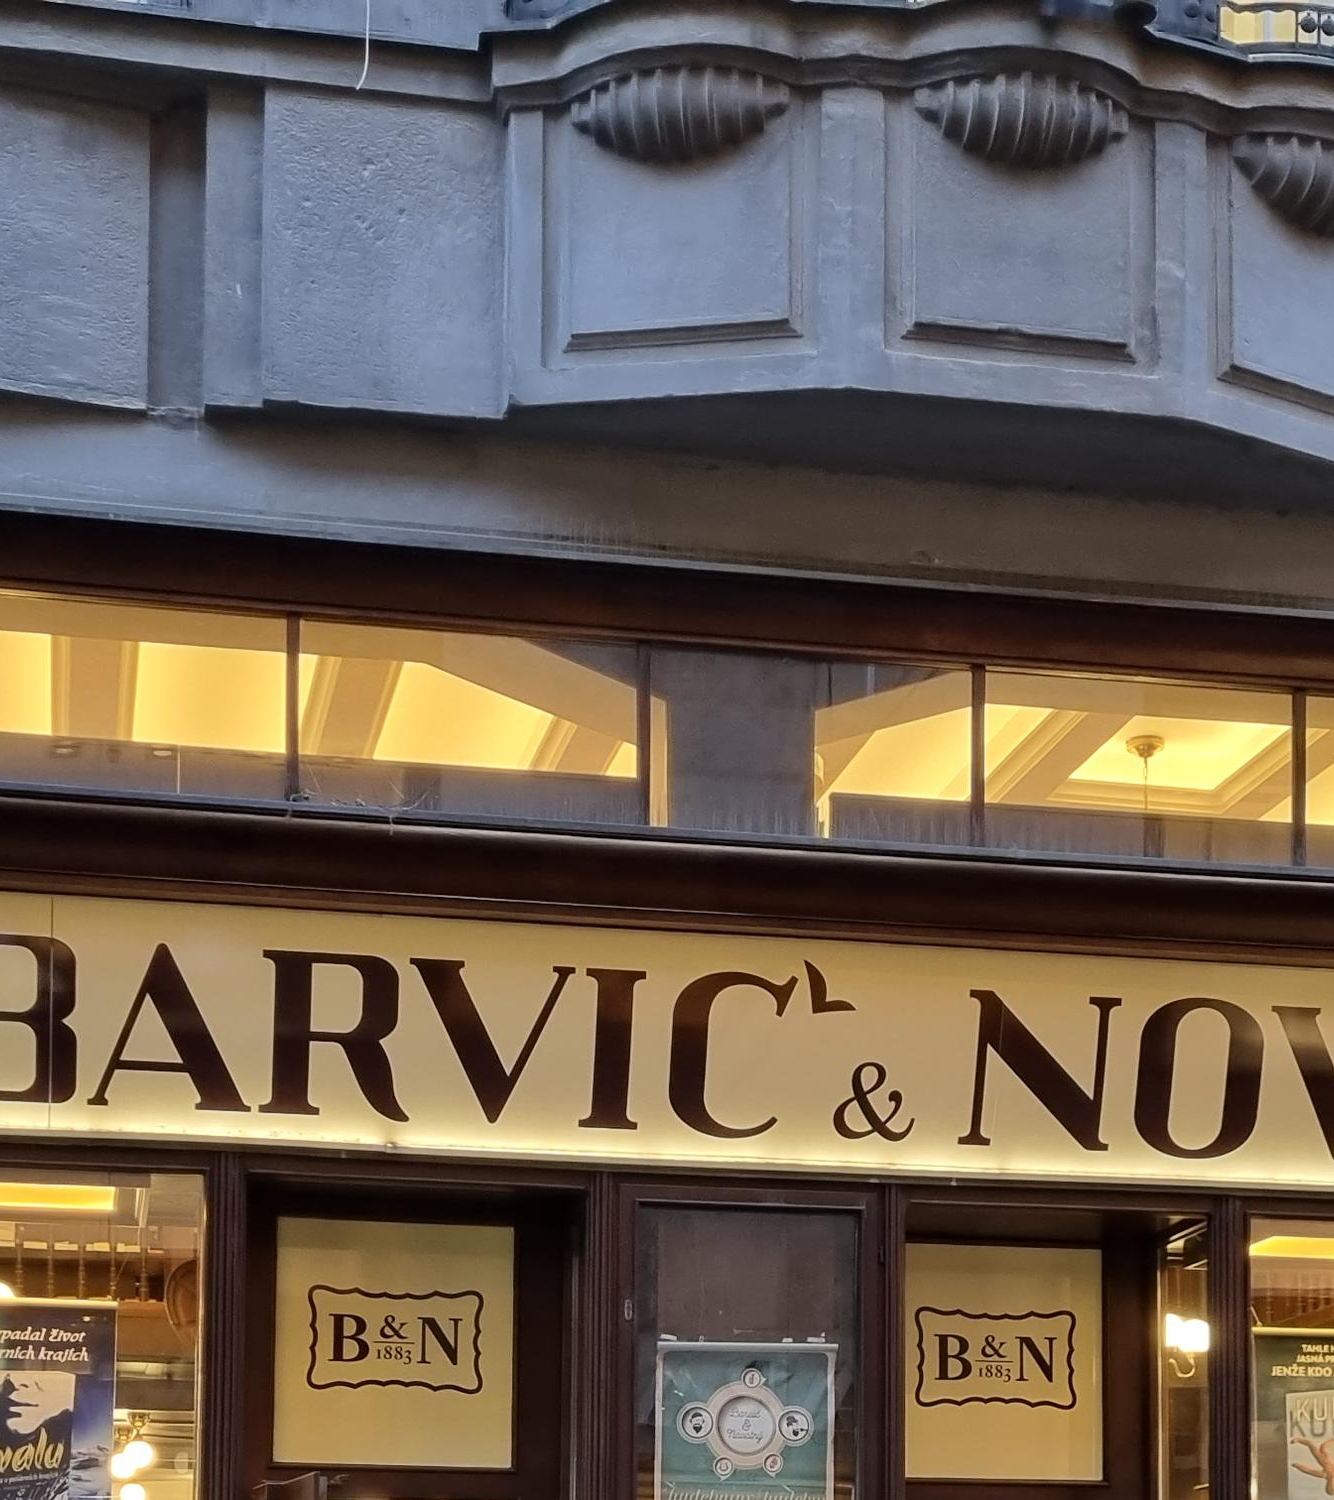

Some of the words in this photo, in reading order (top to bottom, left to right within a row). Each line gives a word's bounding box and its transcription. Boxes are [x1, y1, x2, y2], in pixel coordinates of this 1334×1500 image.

[832, 1061, 915, 1141] &
[38, 1347, 90, 1363] krajích
[376, 1345, 412, 1365] 1883
[1301, 1343, 1330, 1354] TAHLE
[978, 1364, 1012, 1383] 1883
[1271, 1364, 1307, 1378] JENŽE
[1307, 1365, 1332, 1378] KDO
